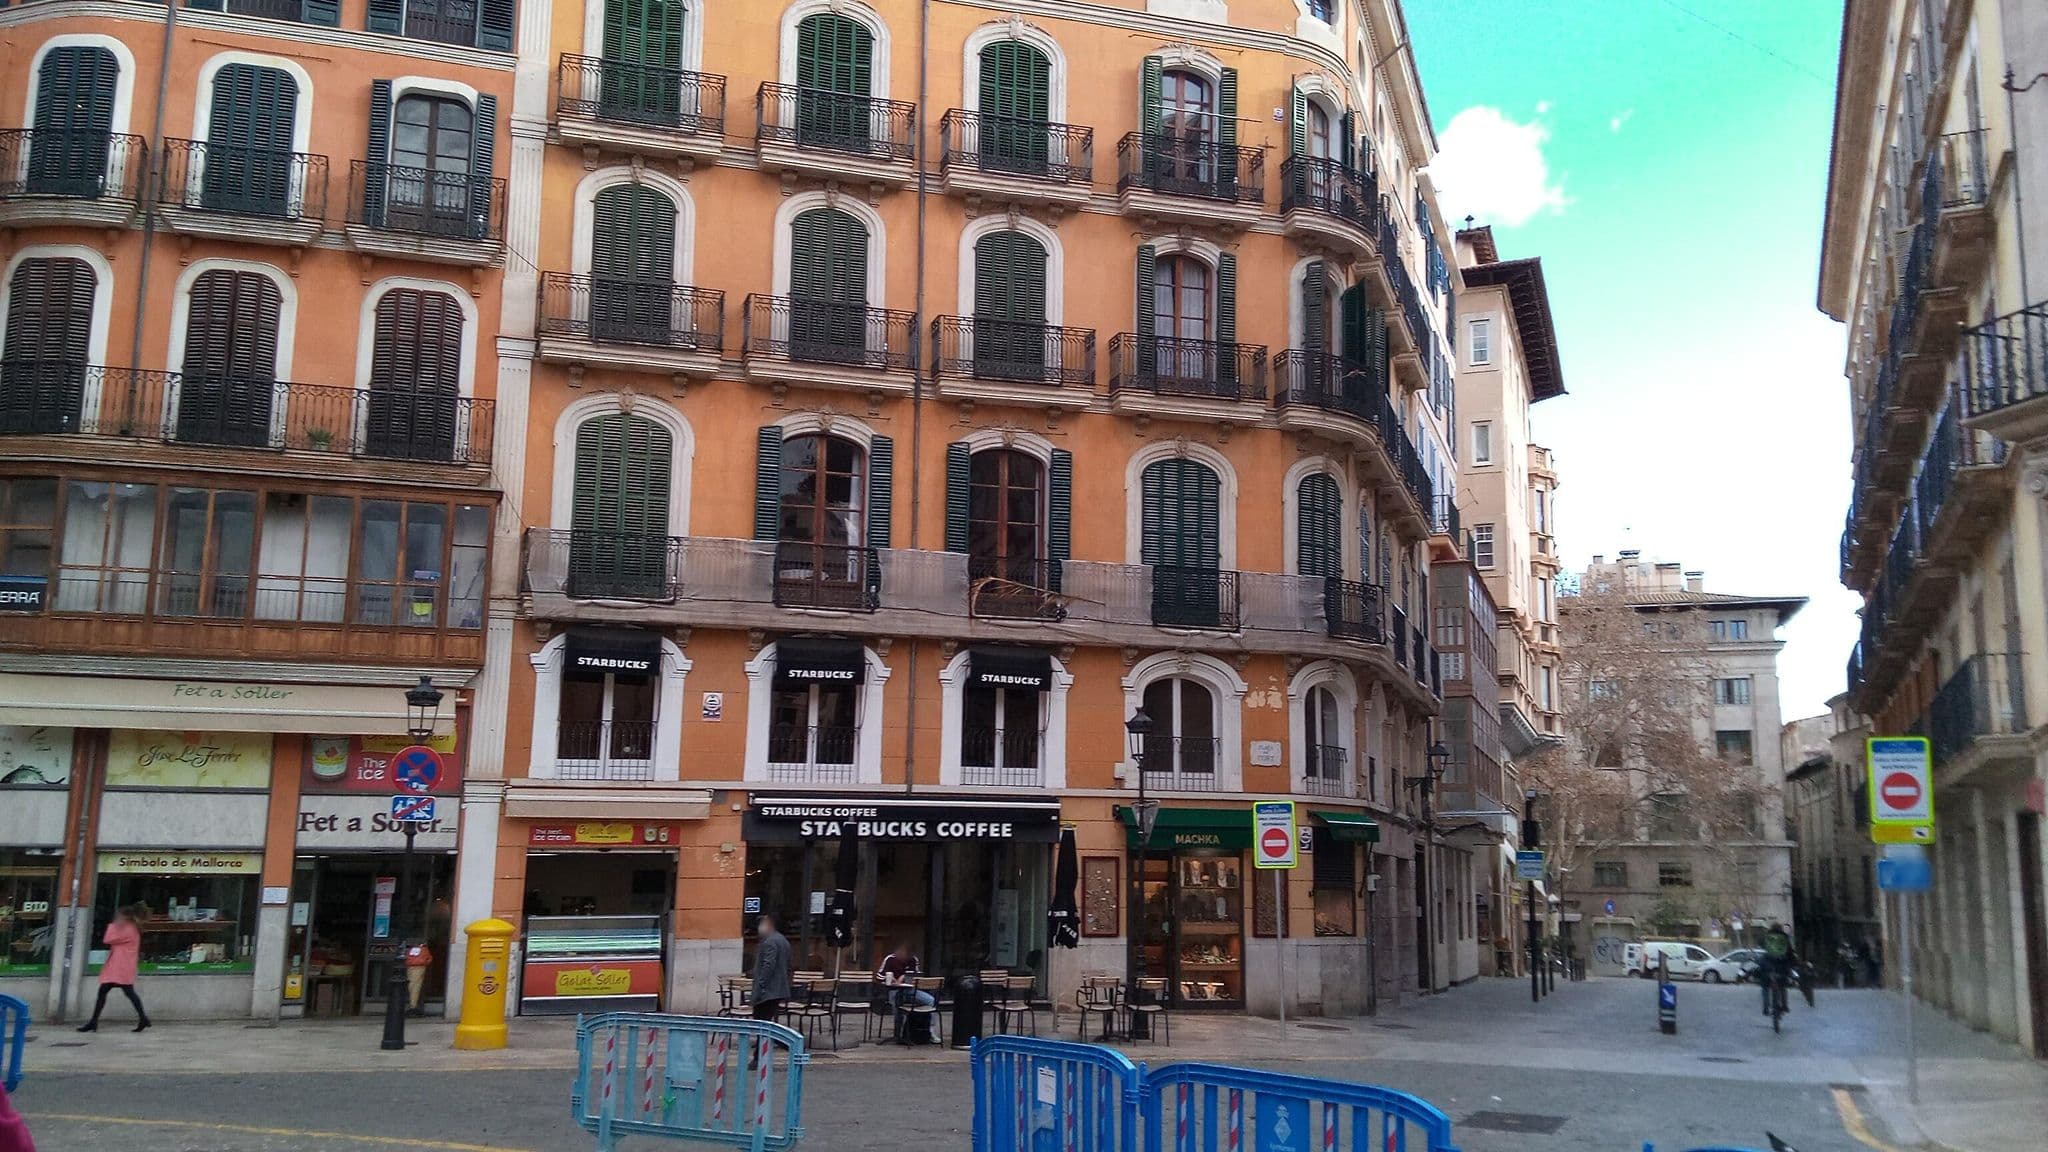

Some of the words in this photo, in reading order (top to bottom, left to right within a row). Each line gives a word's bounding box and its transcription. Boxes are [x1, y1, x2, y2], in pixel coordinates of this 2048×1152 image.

[577, 656, 651, 670] STARBUCKS
[788, 669, 856, 679] STARBUCKS
[981, 674, 1042, 686] STARBUCKS
[173, 684, 207, 697] Fet
[210, 688, 224, 698] a
[363, 757, 387, 768] The
[357, 766, 385, 780] ice
[761, 807, 832, 816] STARBUCKS
[833, 807, 877, 817] COFFEE
[298, 812, 338, 832] Fet
[347, 816, 361, 832] a
[371, 812, 442, 833] Soer
[800, 821, 926, 837] STABUCKS
[937, 822, 1012, 838] COFFEE
[1175, 834, 1220, 844] MACHKA
[172, 857, 187, 867] de
[191, 858, 243, 868] Mallorca
